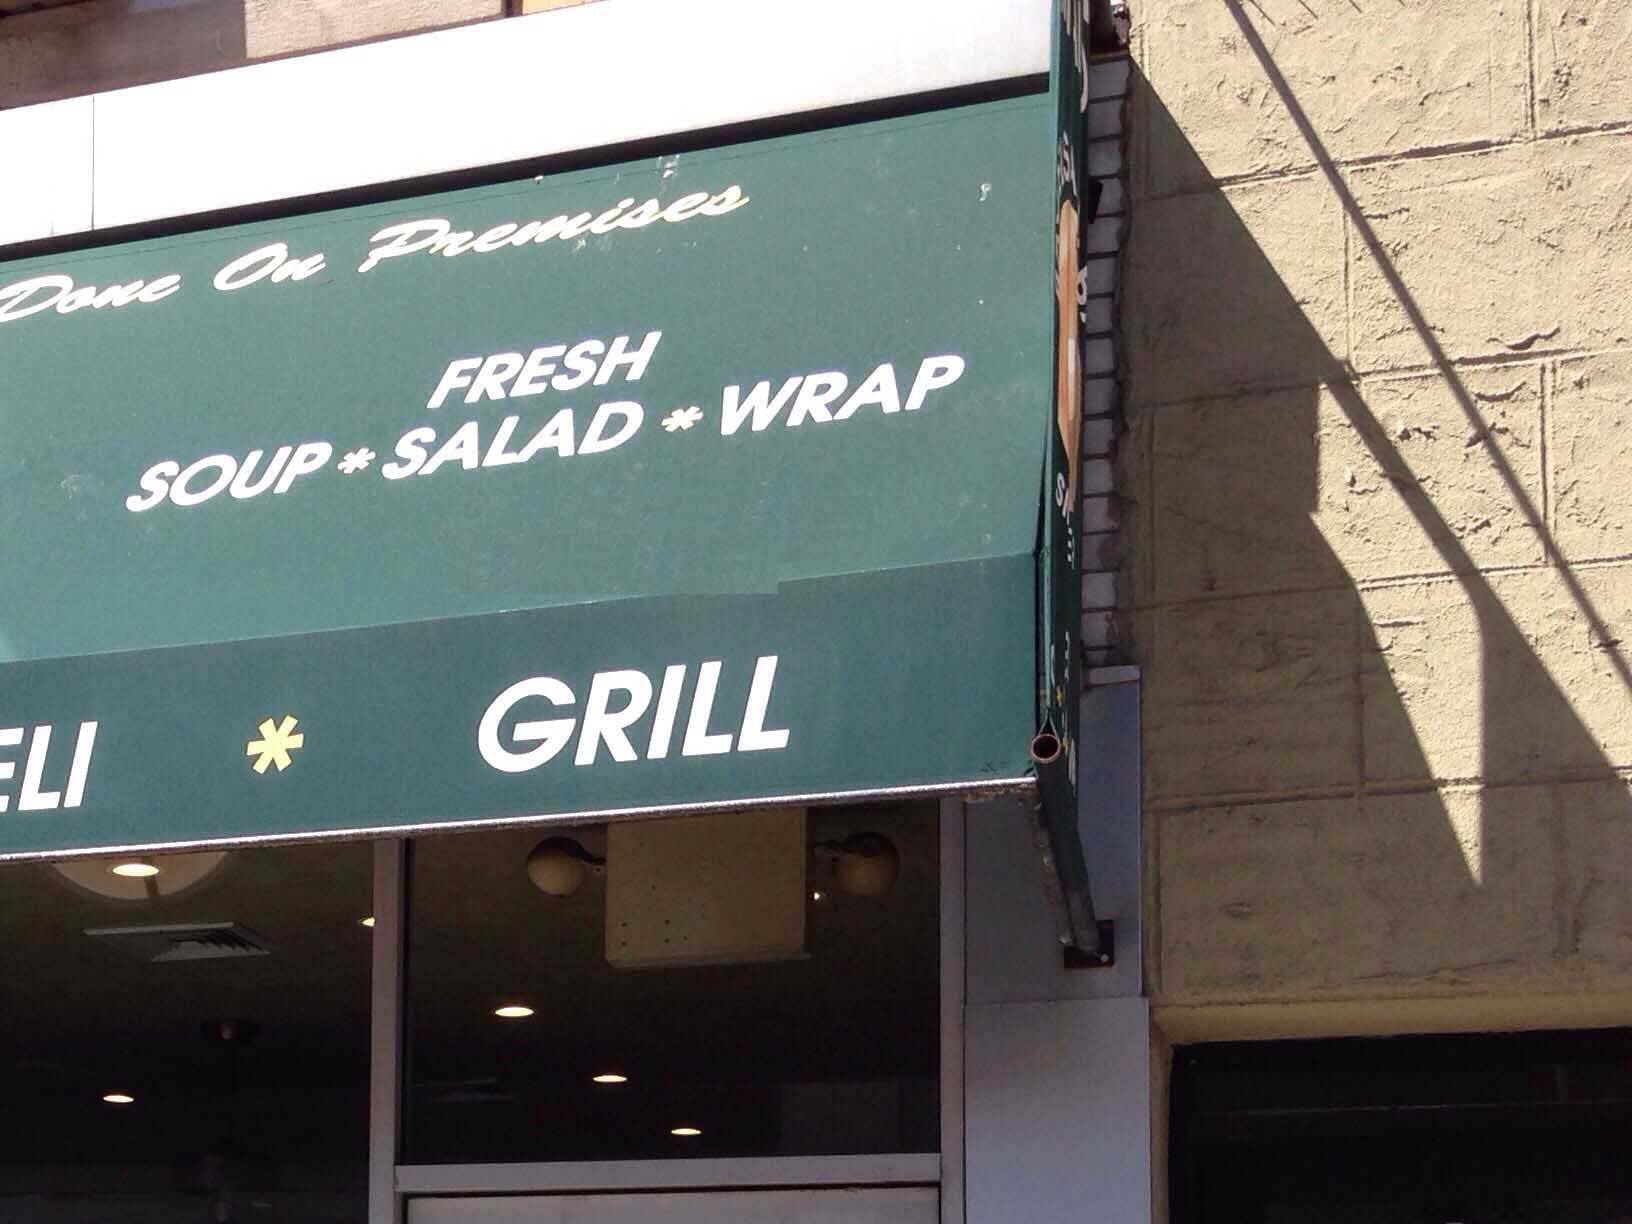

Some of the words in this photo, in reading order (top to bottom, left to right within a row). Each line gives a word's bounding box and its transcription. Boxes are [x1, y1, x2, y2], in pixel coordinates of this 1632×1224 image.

[212, 243, 326, 293] On
[358, 183, 750, 273] Premises
[426, 331, 662, 409] FRESH
[125, 440, 333, 512] SOUP
[381, 400, 644, 481] SALAD
[720, 354, 965, 436] WRAP
[477, 654, 790, 773] GRILL
